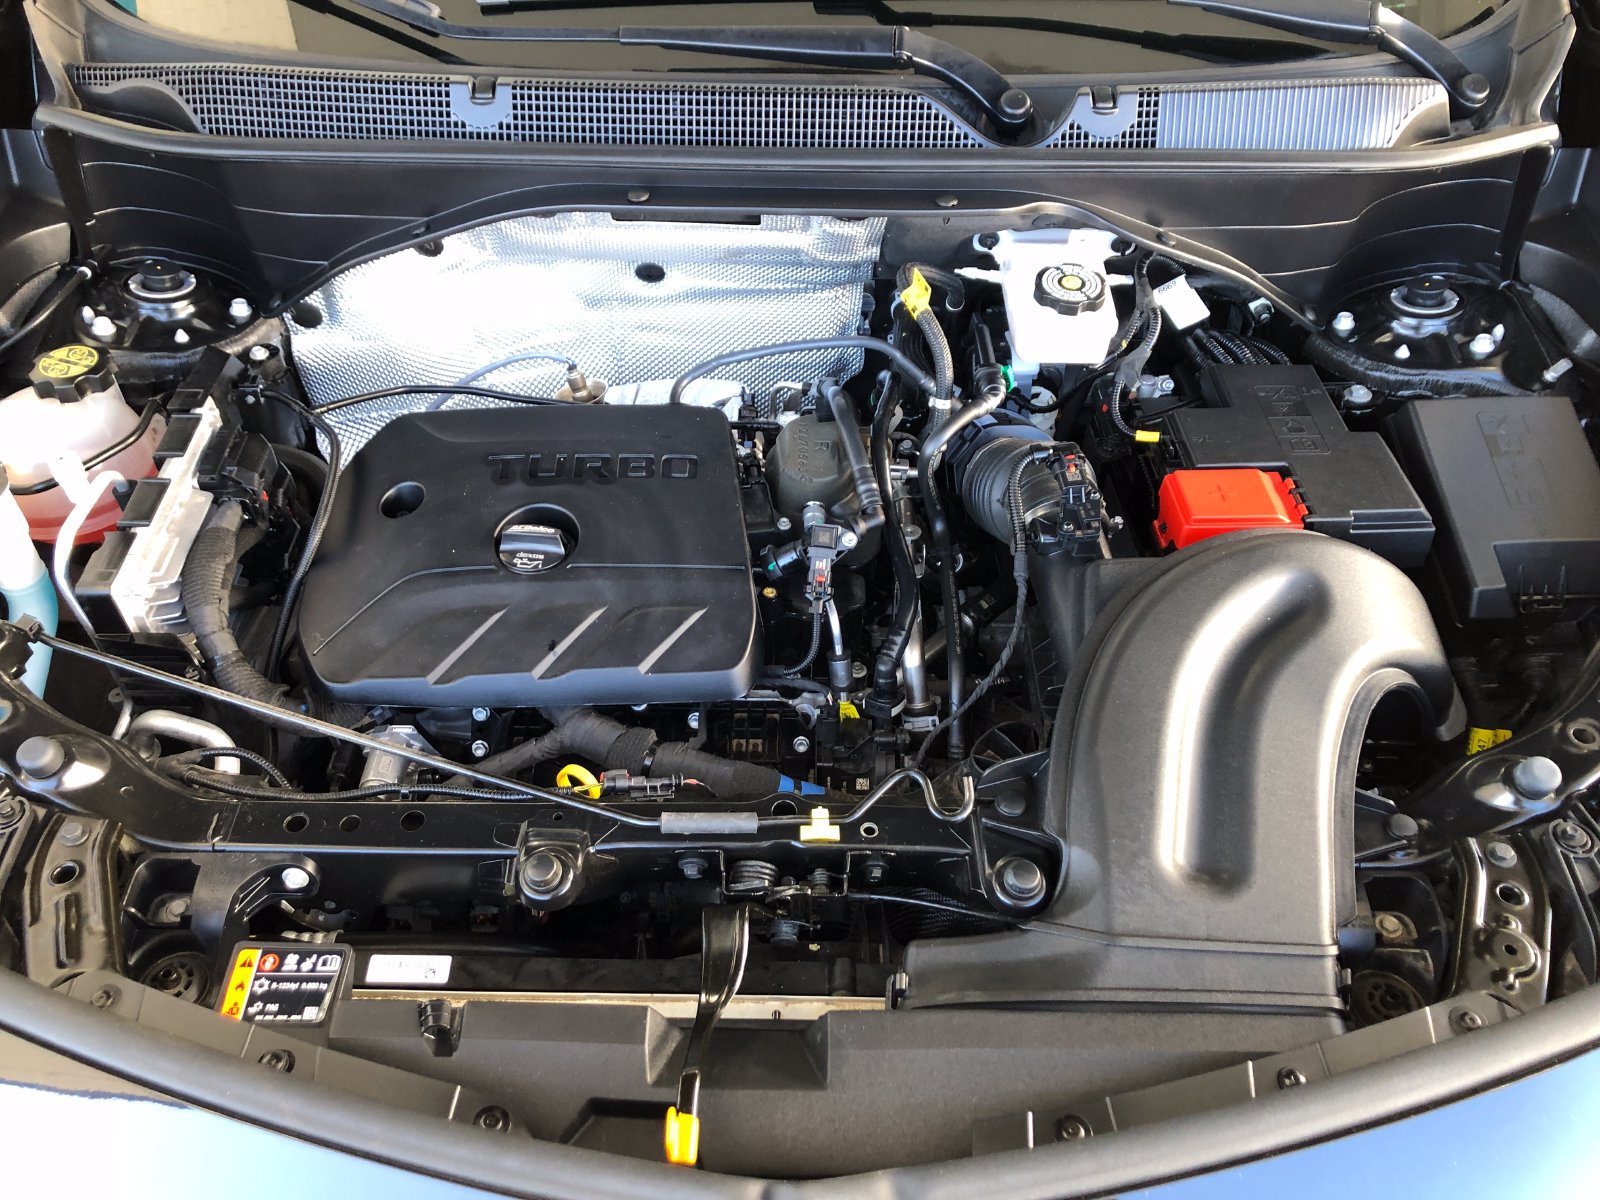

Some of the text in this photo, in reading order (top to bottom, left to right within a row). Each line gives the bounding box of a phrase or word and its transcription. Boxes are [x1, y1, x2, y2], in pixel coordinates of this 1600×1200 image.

[488, 453, 698, 479] TURBO
[510, 524, 555, 533] ACDelco
[516, 551, 545, 560] dexos
[319, 981, 329, 990] kg
[264, 1002, 279, 1012] PAG
